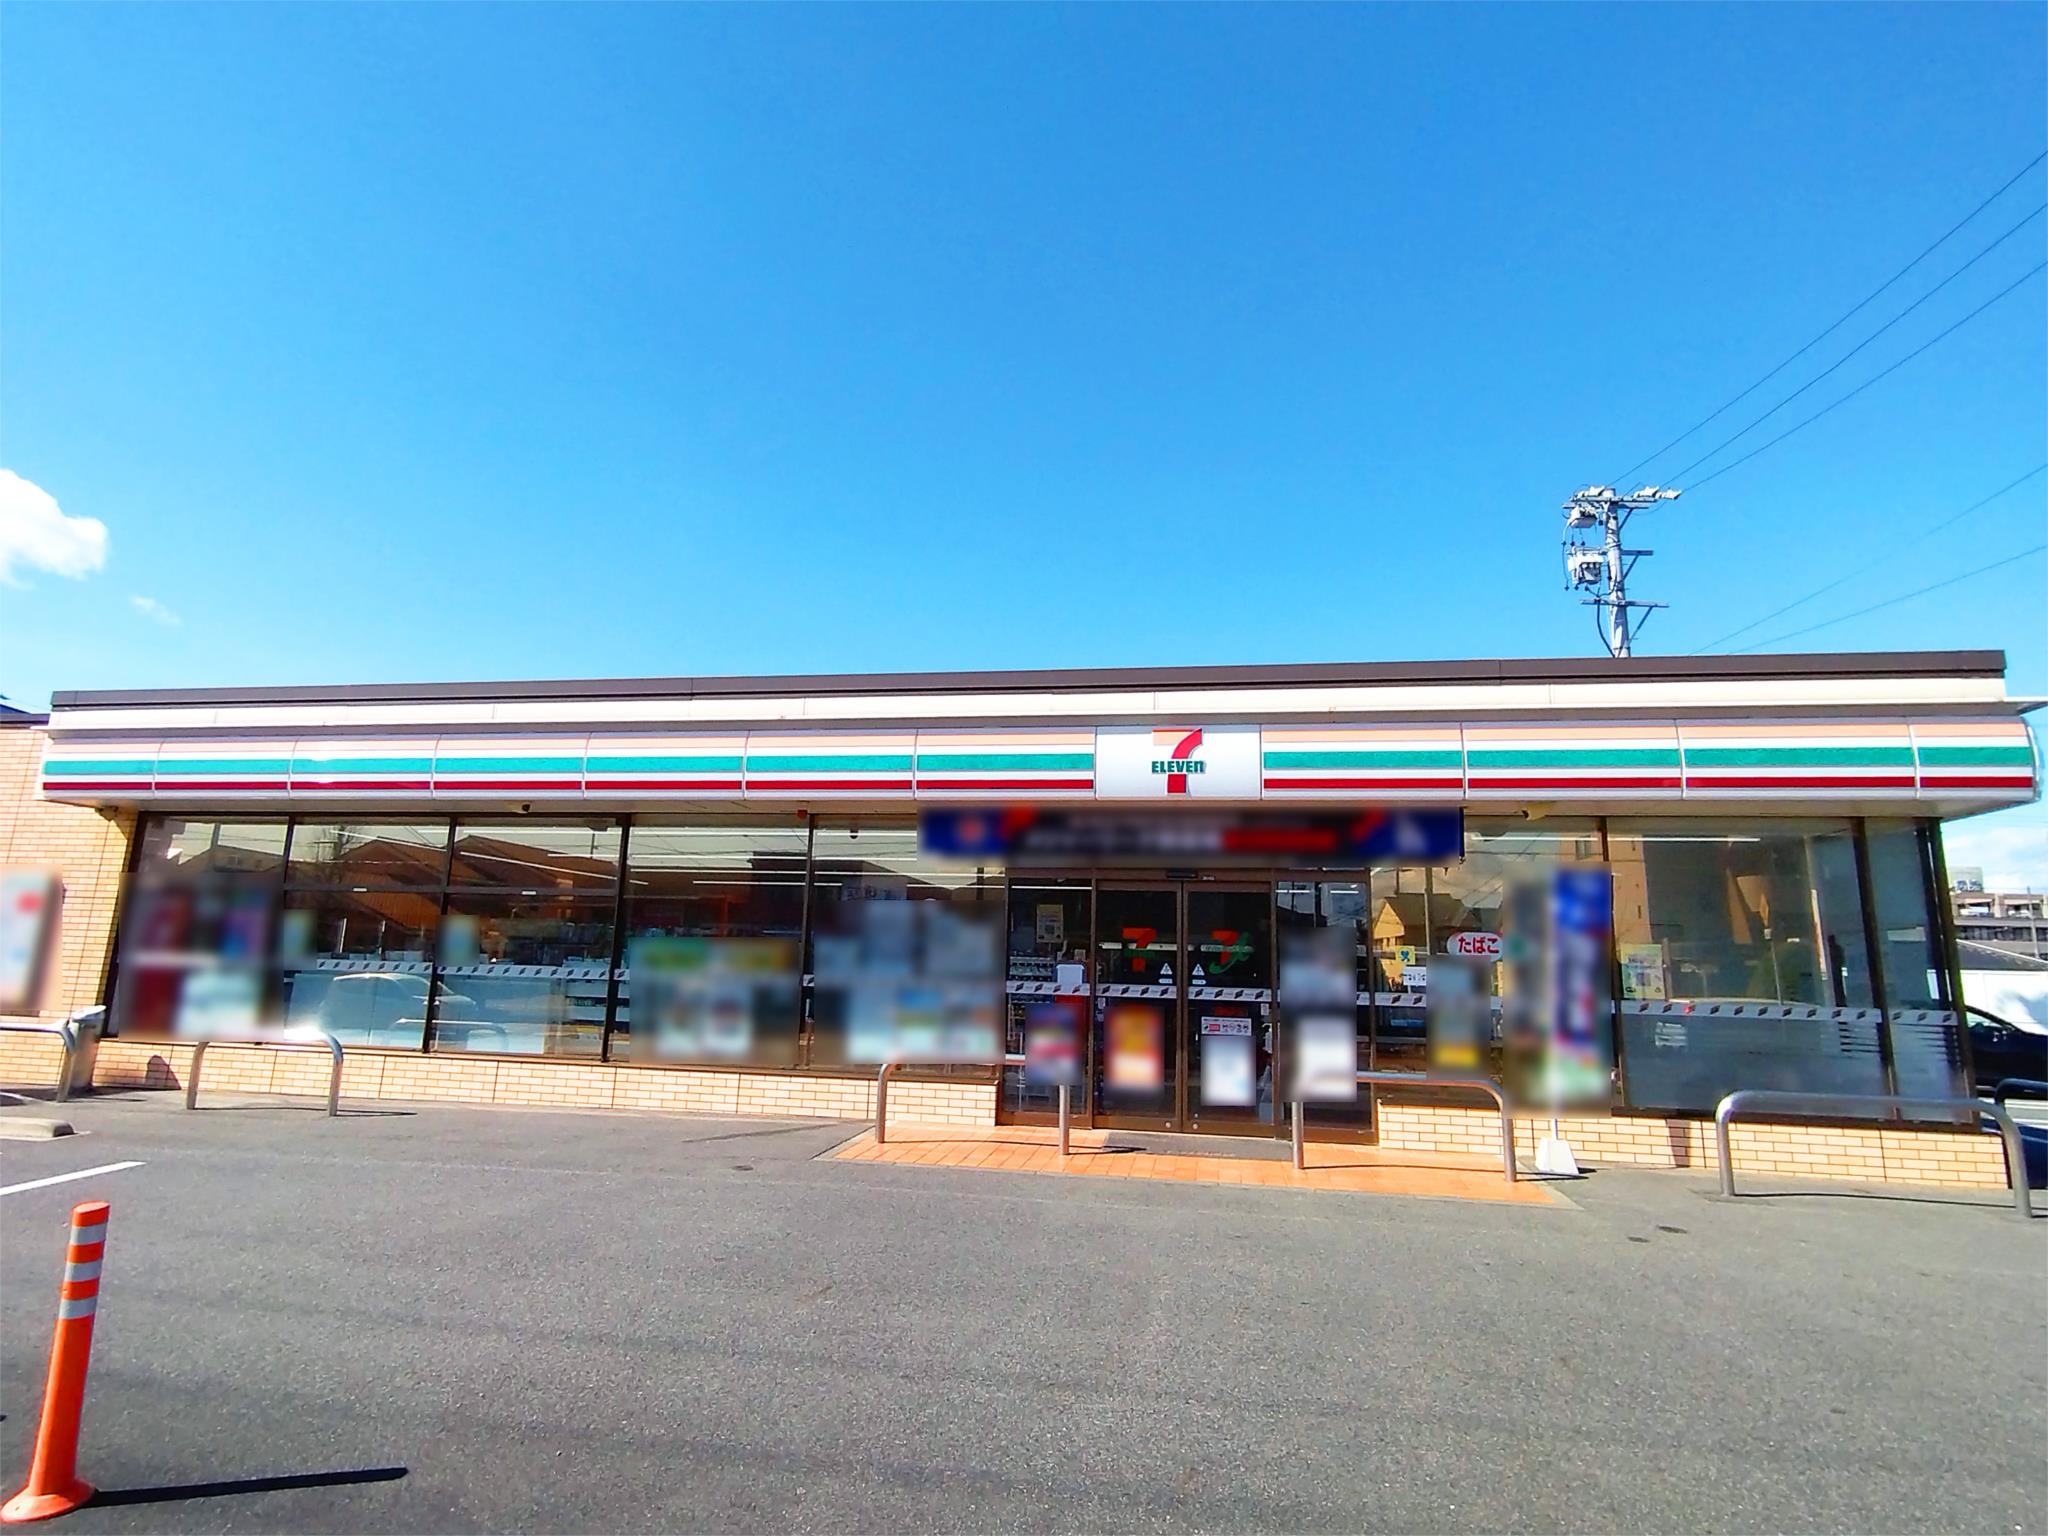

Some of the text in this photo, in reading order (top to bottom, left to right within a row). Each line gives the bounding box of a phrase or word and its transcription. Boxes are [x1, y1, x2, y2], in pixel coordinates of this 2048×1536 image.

[1152, 728, 1203, 794] 7
[1457, 936, 1500, 954] たばこ
